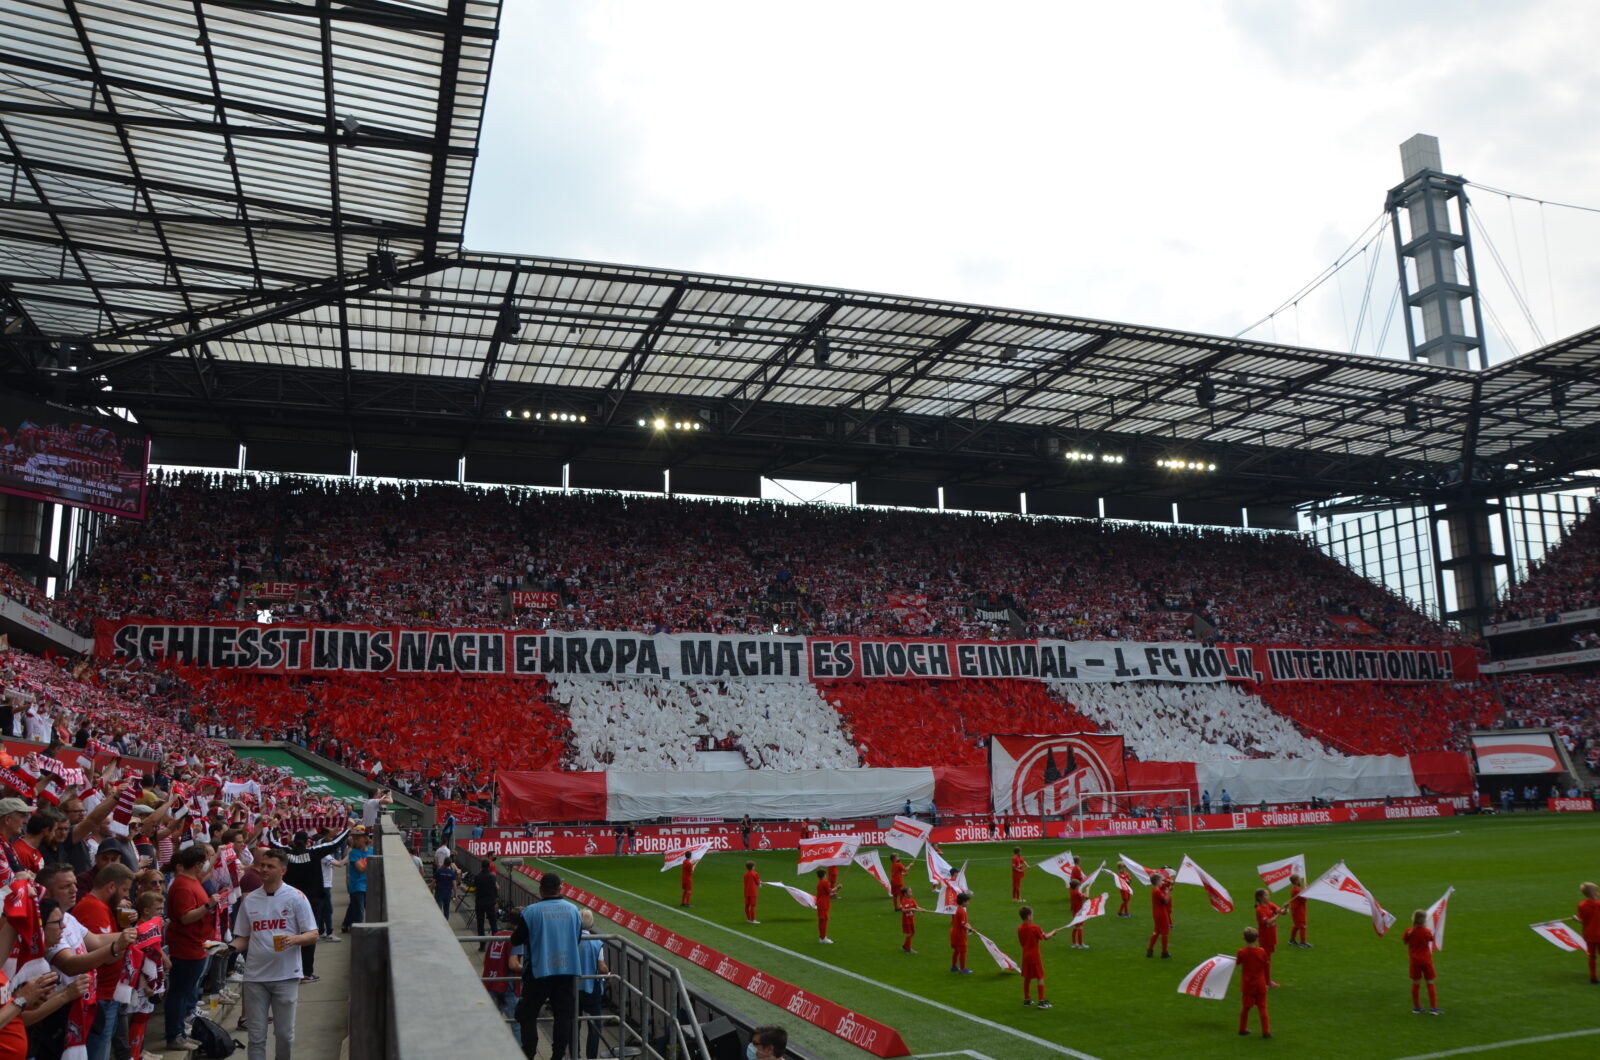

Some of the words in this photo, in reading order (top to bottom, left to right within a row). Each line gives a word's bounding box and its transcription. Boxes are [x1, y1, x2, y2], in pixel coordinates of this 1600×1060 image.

[512, 591, 559, 606] HAWKS
[525, 600, 548, 609] KÖLN
[114, 625, 307, 668] SCHIESST
[312, 630, 393, 670] UNS
[399, 631, 503, 671] NACH
[515, 636, 670, 680] EUROPA,
[680, 640, 803, 676] MACHT
[812, 641, 854, 677] ES
[861, 642, 951, 676] NOCH
[956, 644, 1078, 678] EINMAL
[1114, 648, 1141, 676] 1.
[1144, 648, 1183, 676] FC
[1184, 643, 1263, 683] KÖLN,
[1267, 650, 1454, 680] INTERNATIONAL!
[0, 765, 31, 794] ERSDORF
[1554, 797, 1593, 810] SPÜRBAR
[1262, 811, 1299, 826] SPÜRBAR
[1300, 811, 1333, 824] ANDERS.
[1411, 805, 1440, 818] ANDERS.
[504, 840, 556, 855] ANDERS.
[252, 918, 287, 931] REWE
[715, 958, 739, 982] DERTOUR
[747, 973, 776, 1000] DERTOUR
[787, 992, 820, 1022] DERTOUR
[835, 1014, 878, 1050] DERTOUR
